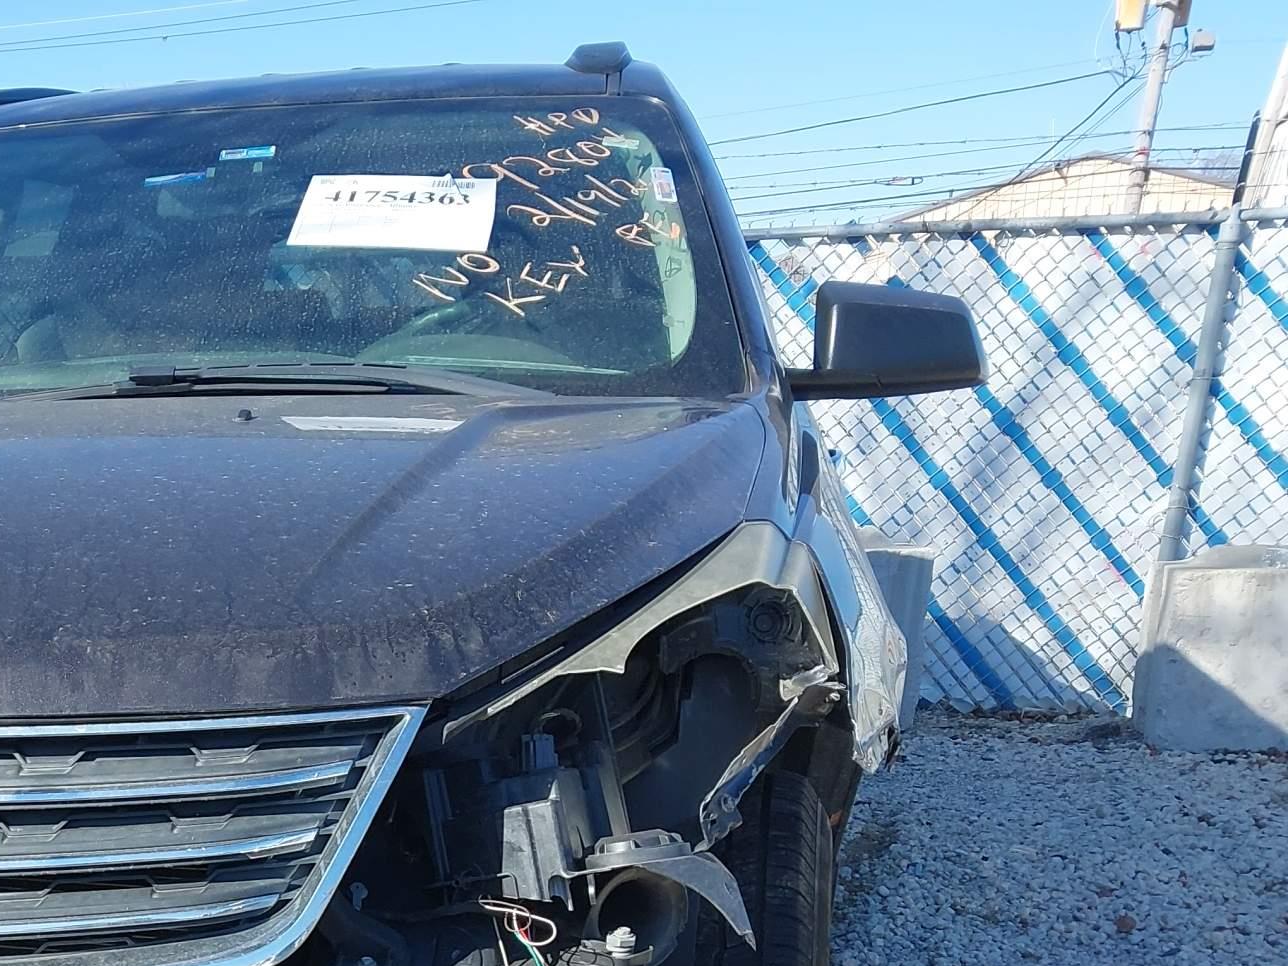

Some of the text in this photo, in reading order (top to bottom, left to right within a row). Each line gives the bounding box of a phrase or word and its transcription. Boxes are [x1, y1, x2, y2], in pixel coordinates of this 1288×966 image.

[325, 190, 471, 206] 41754363
[413, 252, 500, 301] NO
[485, 245, 589, 317] KEY
